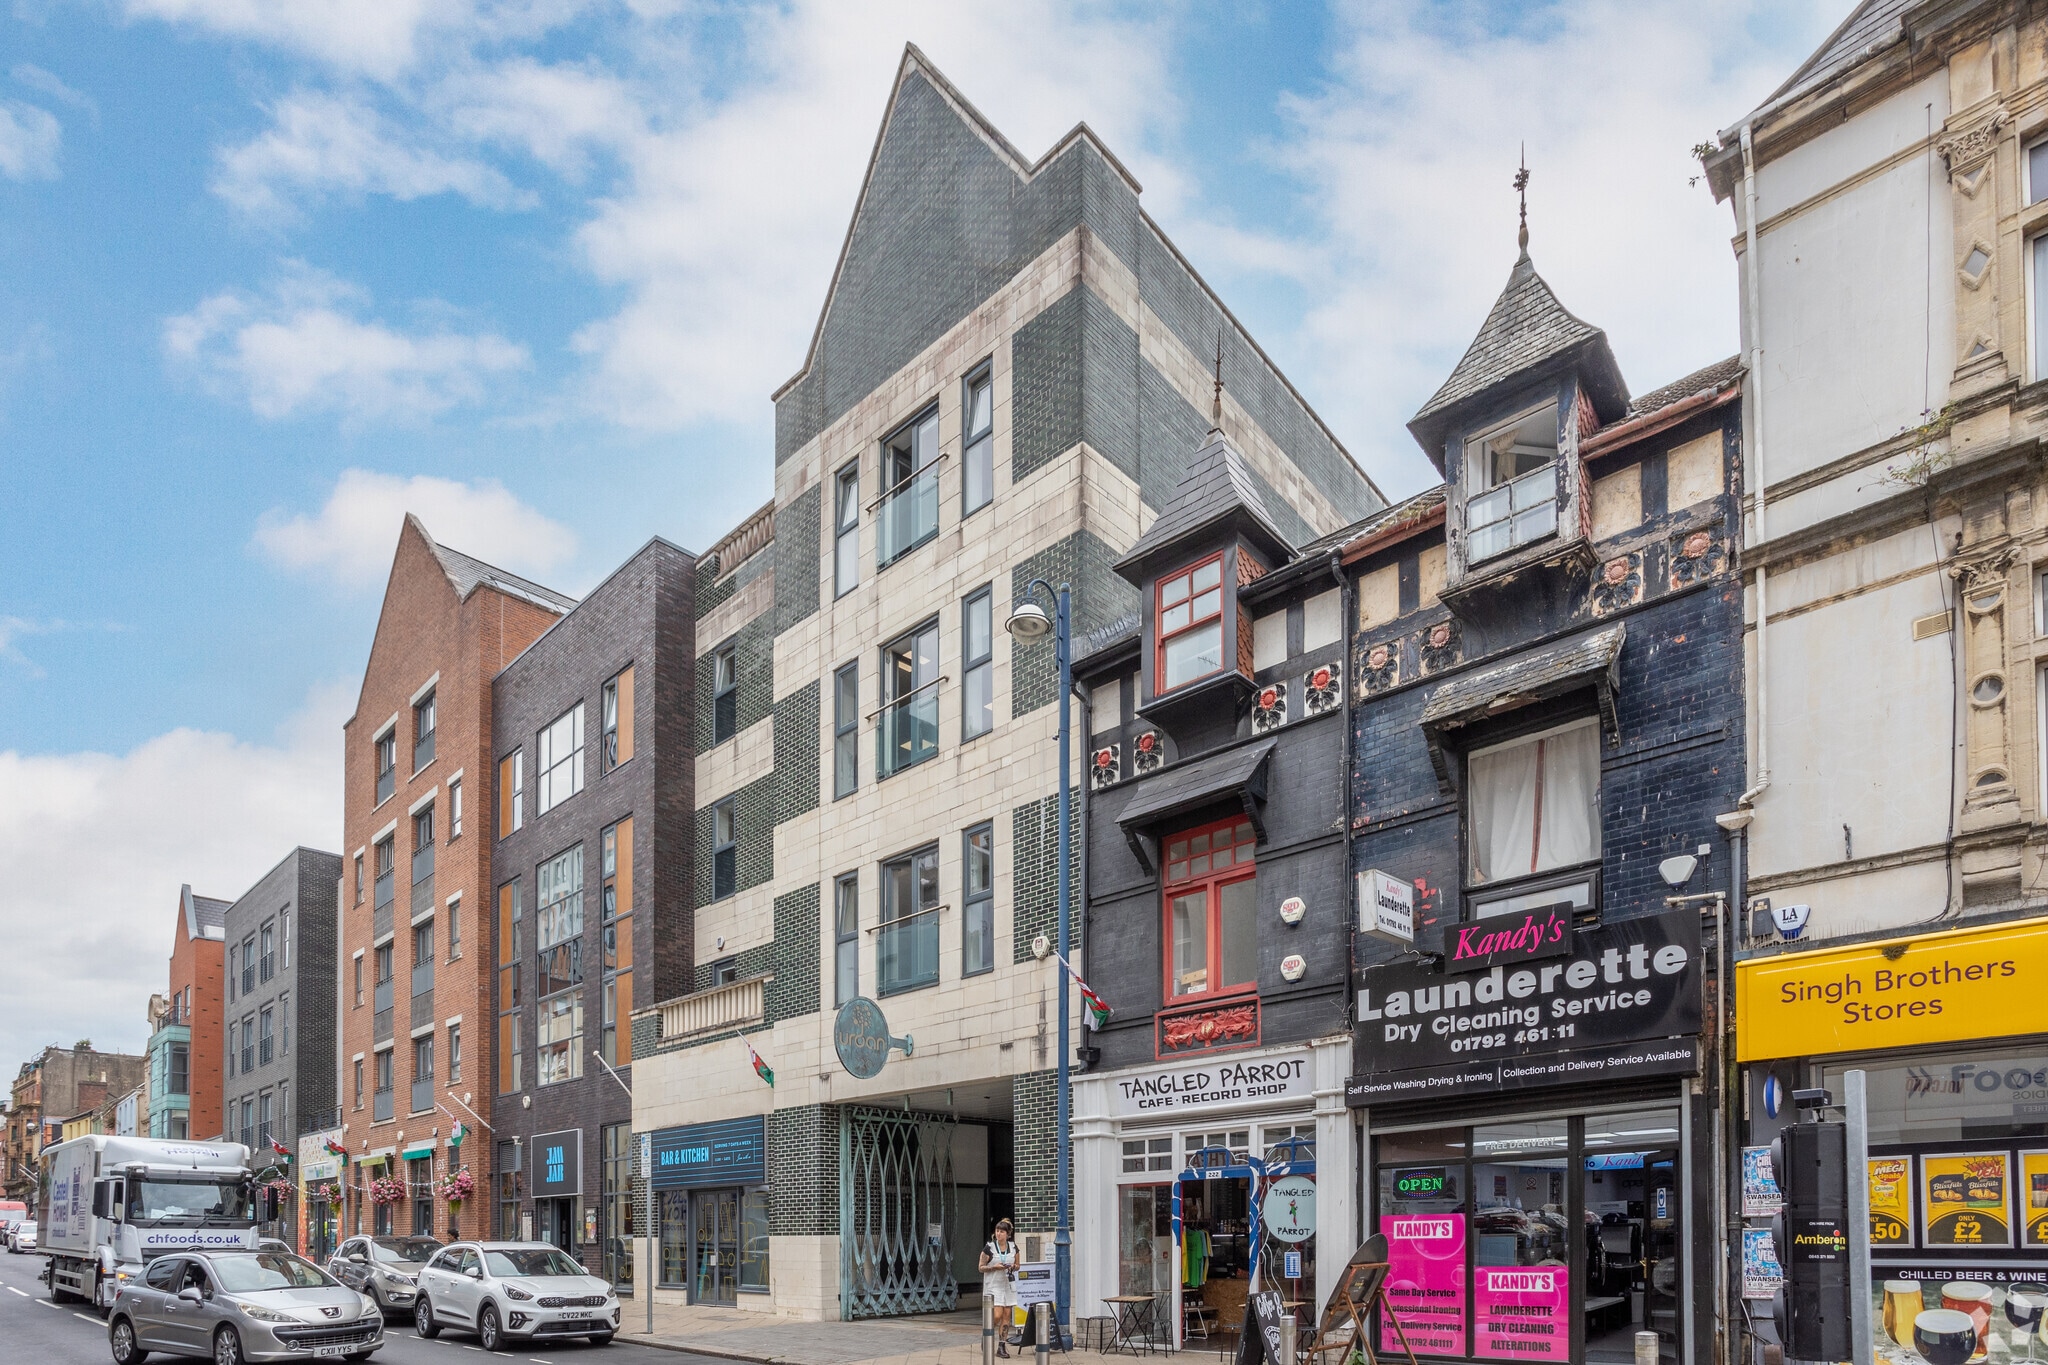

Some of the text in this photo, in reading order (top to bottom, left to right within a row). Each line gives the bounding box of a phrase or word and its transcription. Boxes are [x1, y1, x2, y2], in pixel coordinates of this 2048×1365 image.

[1378, 890, 1410, 917] Launderette
[1782, 908, 1798, 921] LA
[1452, 915, 1566, 960] Kandy's
[1358, 944, 1688, 1021] Launderette
[1780, 961, 2016, 1004] Singh Brothers
[1384, 987, 1652, 1043] Dry Cleaning Service
[1843, 999, 1943, 1024] Stores
[839, 1028, 886, 1051] urban
[1450, 1033, 1506, 1052] 01792
[1503, 1050, 1691, 1078] Collection and Delivery Service Available
[1119, 1060, 1305, 1099] TANGLED PARROT
[1348, 1072, 1493, 1095] Self Service Washing Drying & Ironing
[1247, 1083, 1287, 1097] SHOP
[1485, 1138, 1556, 1150] FREE DELIVERY
[546, 1146, 564, 1165] JAM
[661, 1147, 709, 1166] BAR & KITCHEN
[1585, 1155, 1643, 1168] to Kand
[546, 1164, 564, 1183] JAR
[1874, 1164, 1906, 1176] MEGA
[1398, 1177, 1443, 1191] OPEN
[1273, 1188, 1314, 1197] TANGLED
[1277, 1227, 1310, 1236] PARROT
[1396, 1222, 1450, 1237] KANDY'S
[1954, 1221, 1982, 1239] £2
[147, 1233, 241, 1244] chfoods.co.uk
[1795, 1234, 1846, 1245] Amberon
[1491, 1275, 1551, 1290] KANDY'S
[1899, 1270, 2048, 1282] CHILLED BEER & WINE
[1390, 1288, 1456, 1298] Same Day Service
[1433, 1306, 1461, 1315] Ironing
[1489, 1305, 1553, 1316] LAUNDERETTE
[1401, 1321, 1432, 1331] Delivery
[1433, 1322, 1462, 1331] Service
[1488, 1322, 1554, 1334] DRY CLEANING
[337, 1345, 352, 1353] YYS
[1491, 1340, 1552, 1352] ALTERATIONS
